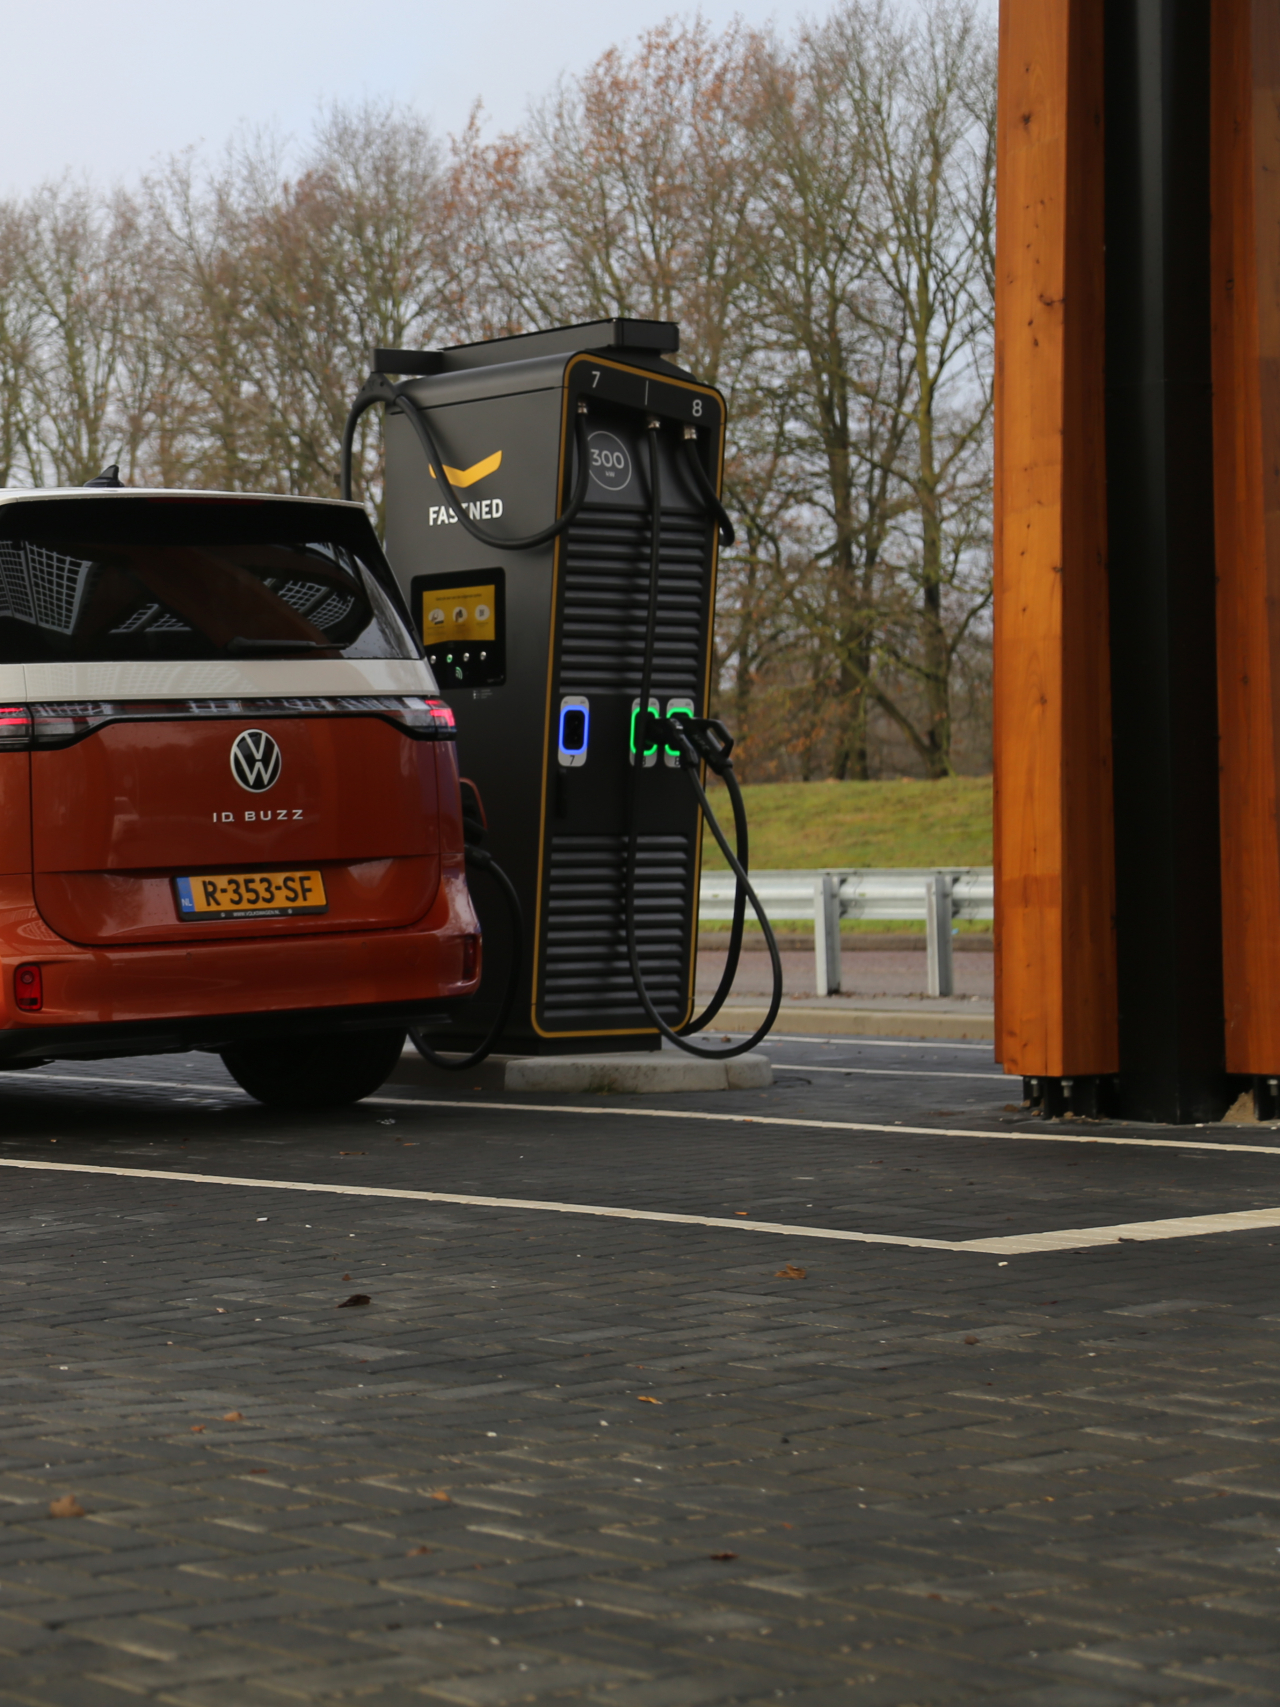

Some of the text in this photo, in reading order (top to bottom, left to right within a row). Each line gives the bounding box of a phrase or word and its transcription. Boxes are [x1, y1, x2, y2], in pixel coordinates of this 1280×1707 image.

[591, 371, 702, 417] 7 8
[590, 448, 625, 469] 300
[569, 755, 575, 765] 7
[245, 809, 304, 822] BUZZ
[202, 876, 313, 908] R-353-SF
[181, 898, 193, 907] NL
